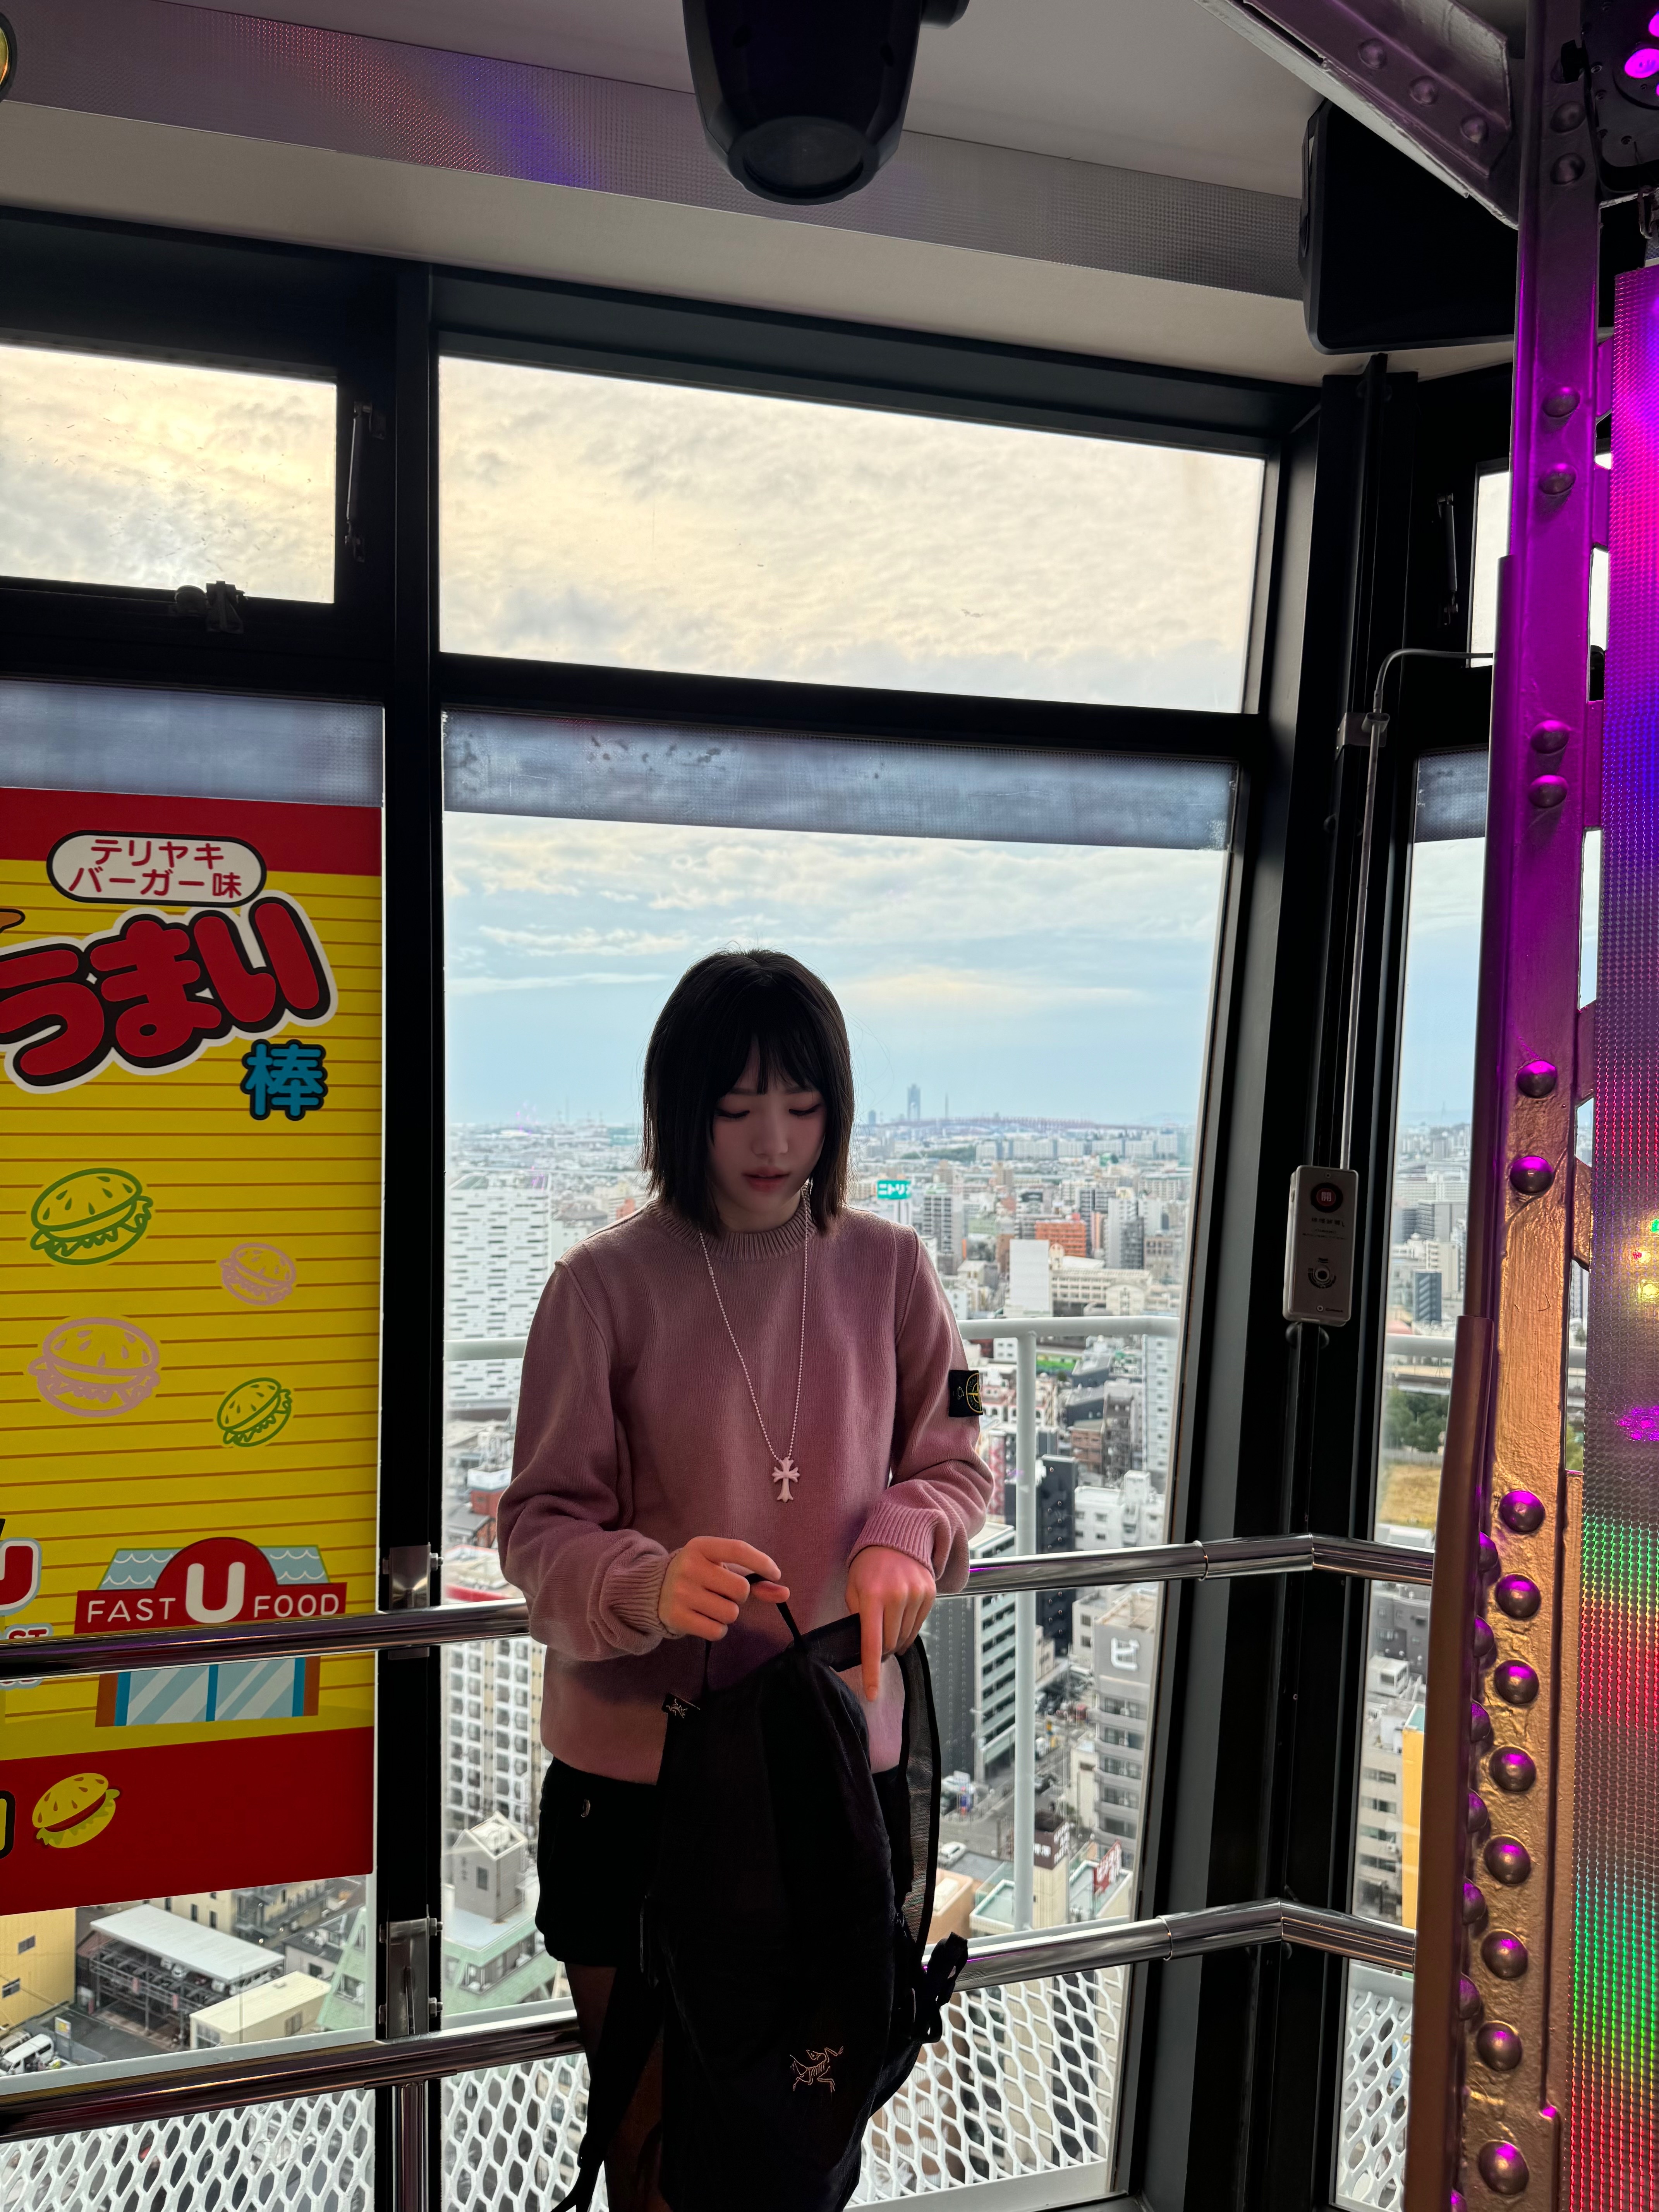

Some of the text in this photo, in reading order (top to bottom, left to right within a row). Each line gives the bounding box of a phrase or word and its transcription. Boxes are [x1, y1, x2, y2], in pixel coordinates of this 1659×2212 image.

[90, 839, 225, 870] テリヤキ
[68, 866, 242, 899] バーガー味
[0, 896, 331, 1087] うまい
[243, 1041, 326, 1119] 棒
[878, 1183, 905, 1195] ニトリ
[87, 1561, 340, 1624] FAST U FOOD
